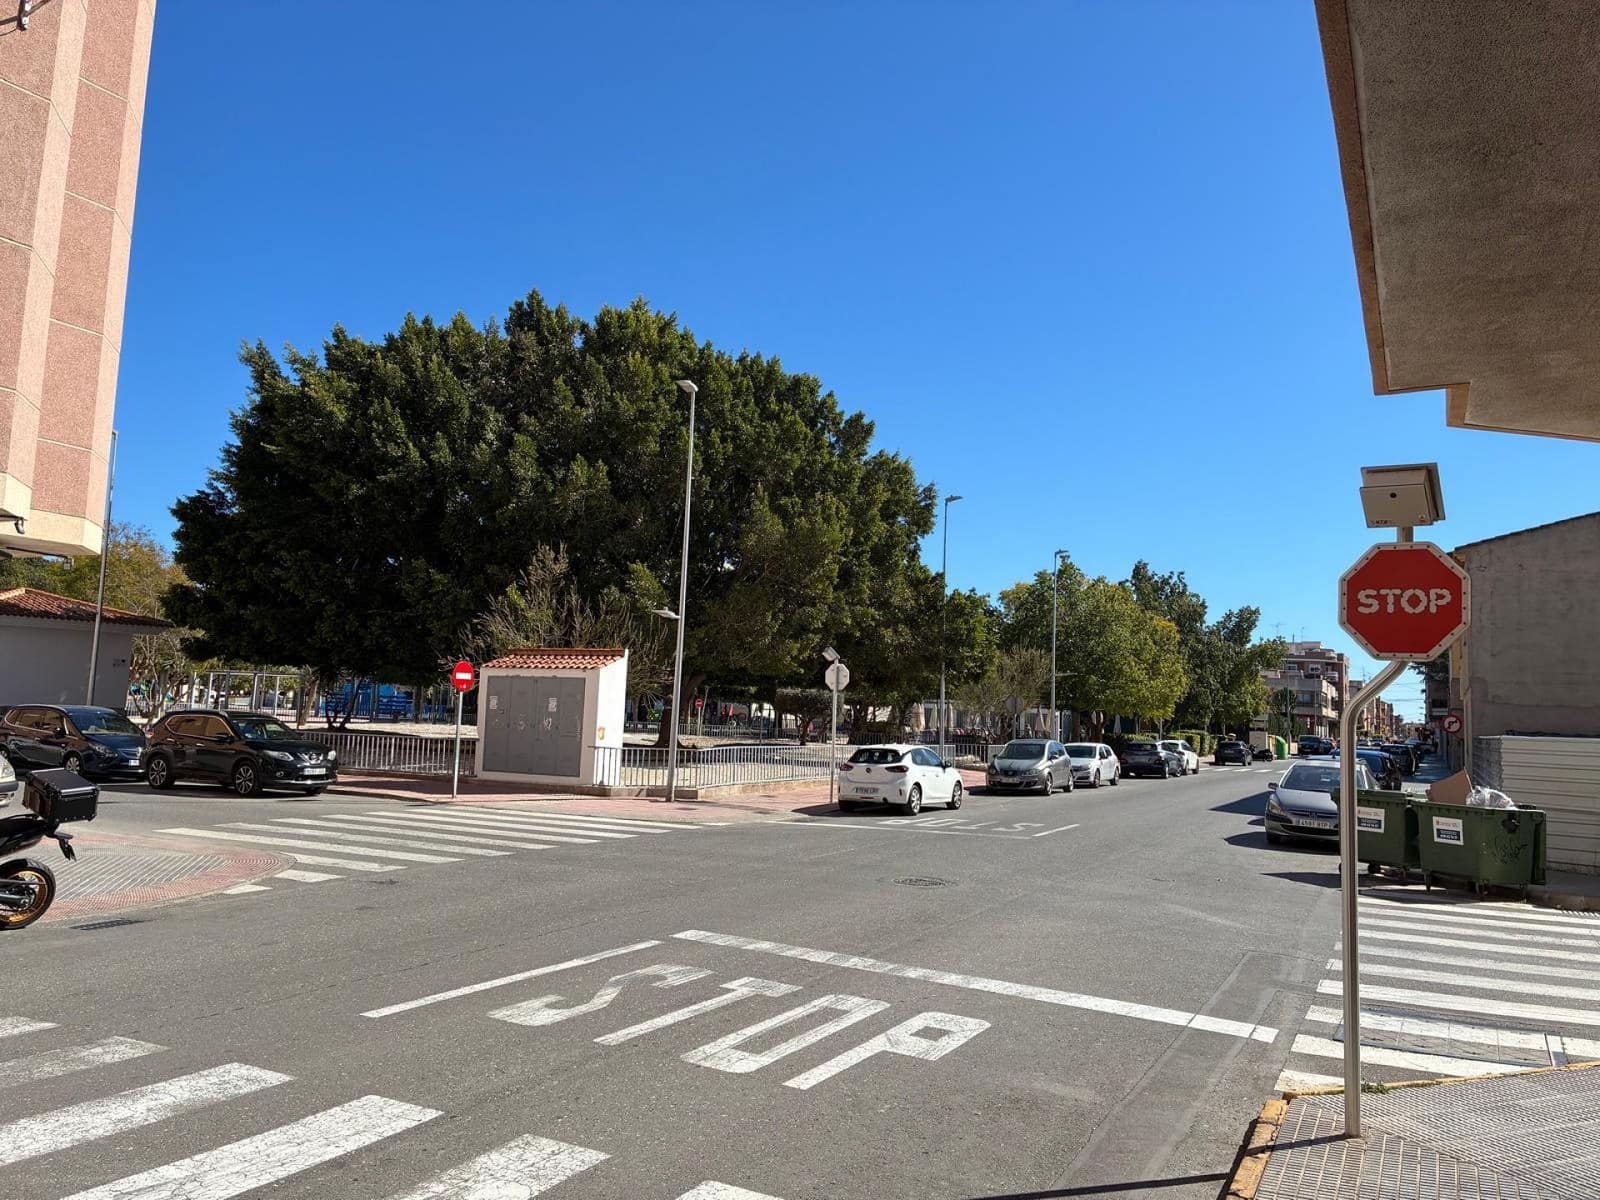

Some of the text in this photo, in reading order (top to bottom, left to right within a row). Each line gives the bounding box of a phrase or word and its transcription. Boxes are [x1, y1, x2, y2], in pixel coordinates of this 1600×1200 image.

[1357, 588, 1452, 614] STOP
[876, 817, 1046, 833] STOP
[486, 963, 992, 1091] STOP
